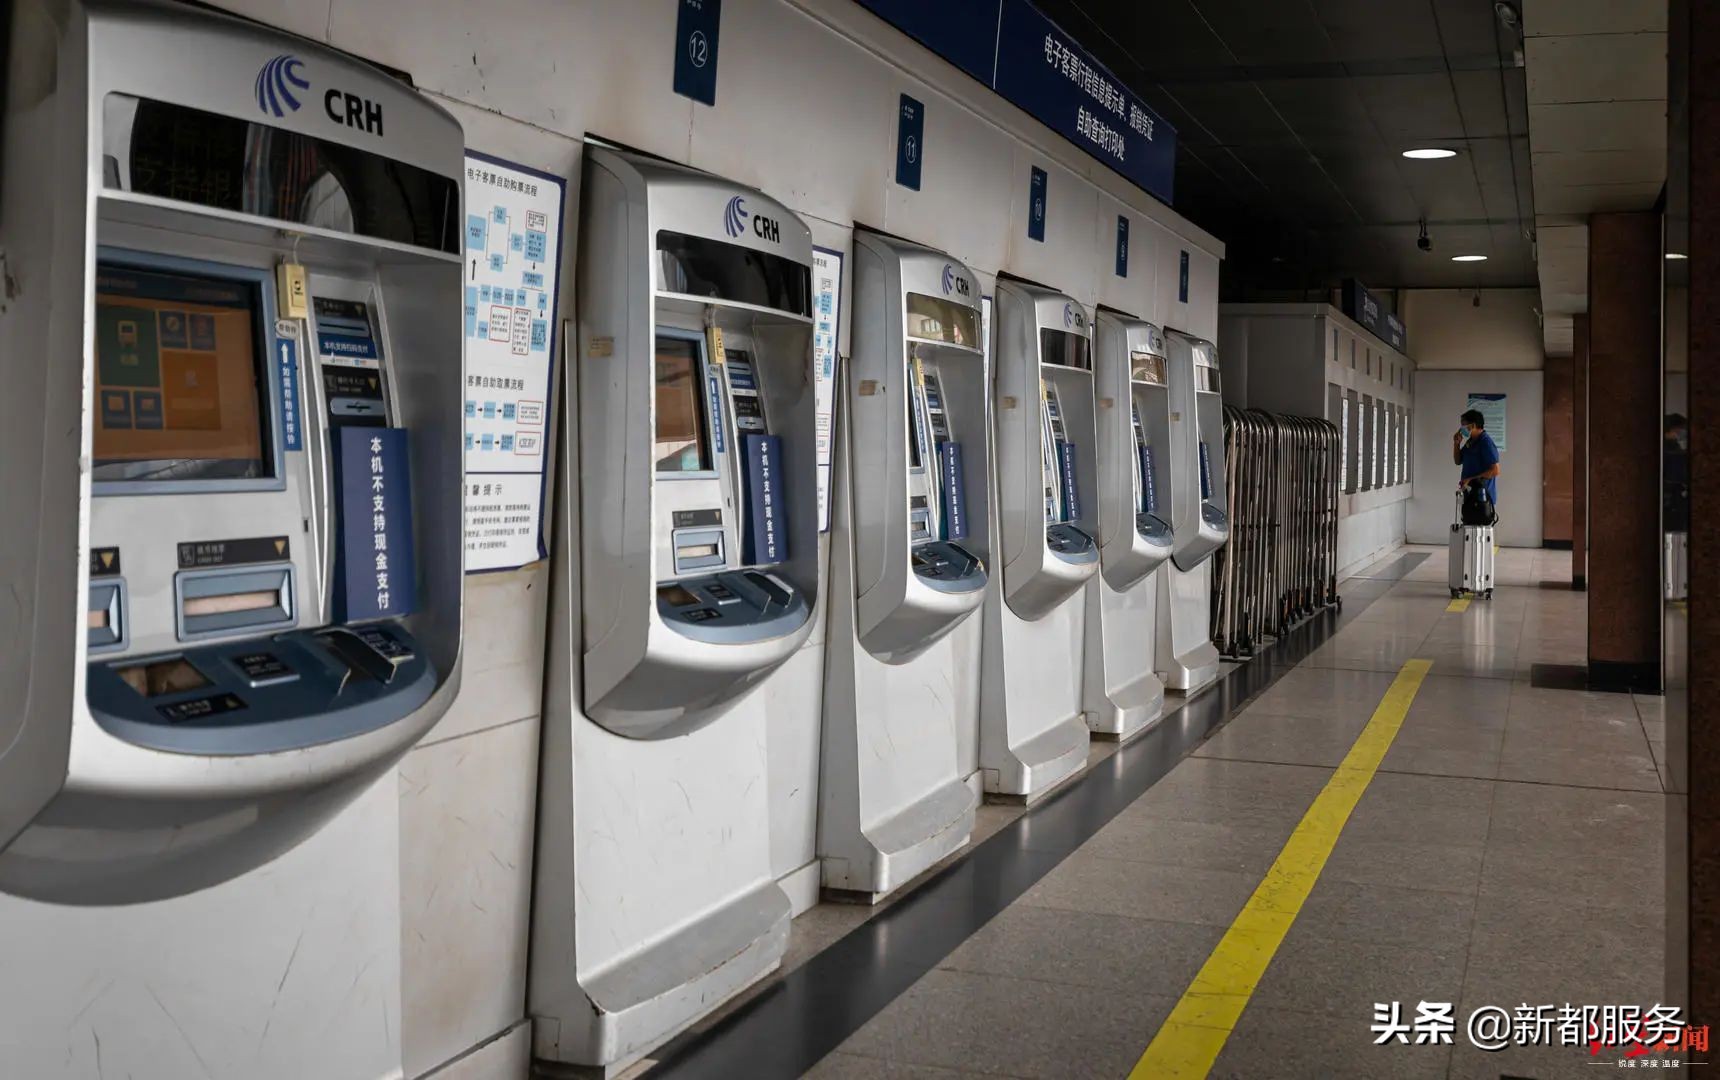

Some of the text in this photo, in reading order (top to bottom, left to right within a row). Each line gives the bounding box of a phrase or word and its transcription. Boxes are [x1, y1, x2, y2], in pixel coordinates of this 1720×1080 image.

[690, 35, 707, 64] 12
[323, 88, 384, 137] CRH
[1076, 105, 1125, 161] 自助查询打印处
[467, 166, 538, 197] 电子客票自助购票流程
[753, 214, 780, 243] CRH
[955, 276, 969, 298] CRH
[760, 440, 776, 559] 本机不支持现金支付
[370, 436, 390, 611] 本机不支持现金支付
